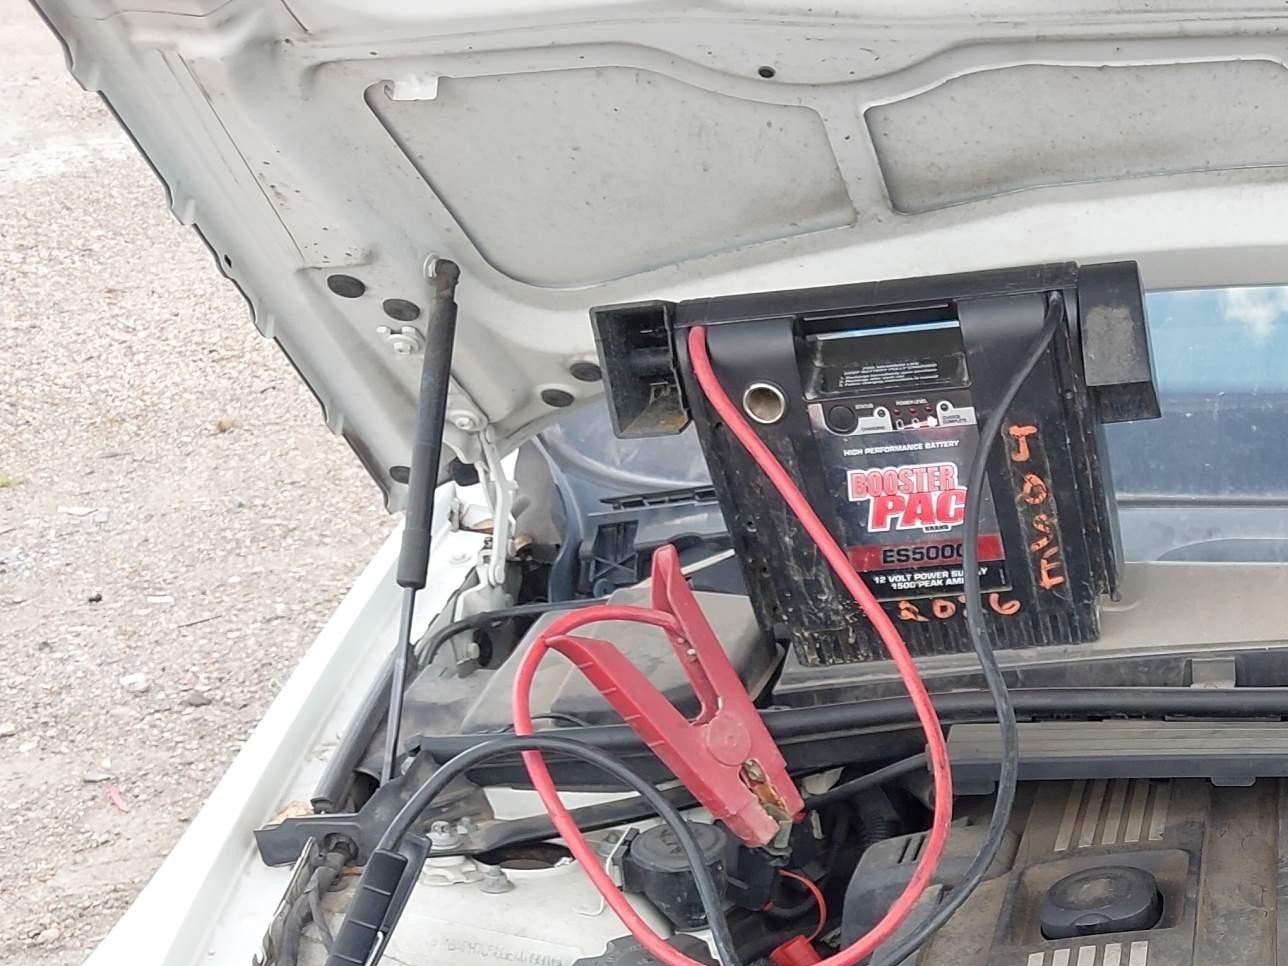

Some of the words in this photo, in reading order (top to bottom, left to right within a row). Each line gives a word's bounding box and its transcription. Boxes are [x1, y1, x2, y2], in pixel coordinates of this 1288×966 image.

[843, 448, 864, 457] HIGH
[865, 443, 923, 455] PERFORMANCE
[924, 439, 960, 450] BATTERY
[850, 464, 956, 499] BOOSTER
[871, 488, 968, 530] PAC
[873, 577, 886, 585] 12
[888, 574, 912, 583] VOLT
[914, 572, 949, 582] POWER
[891, 582, 916, 590] 1500
[917, 579, 944, 588] PEAK
[898, 593, 1021, 622] 206
